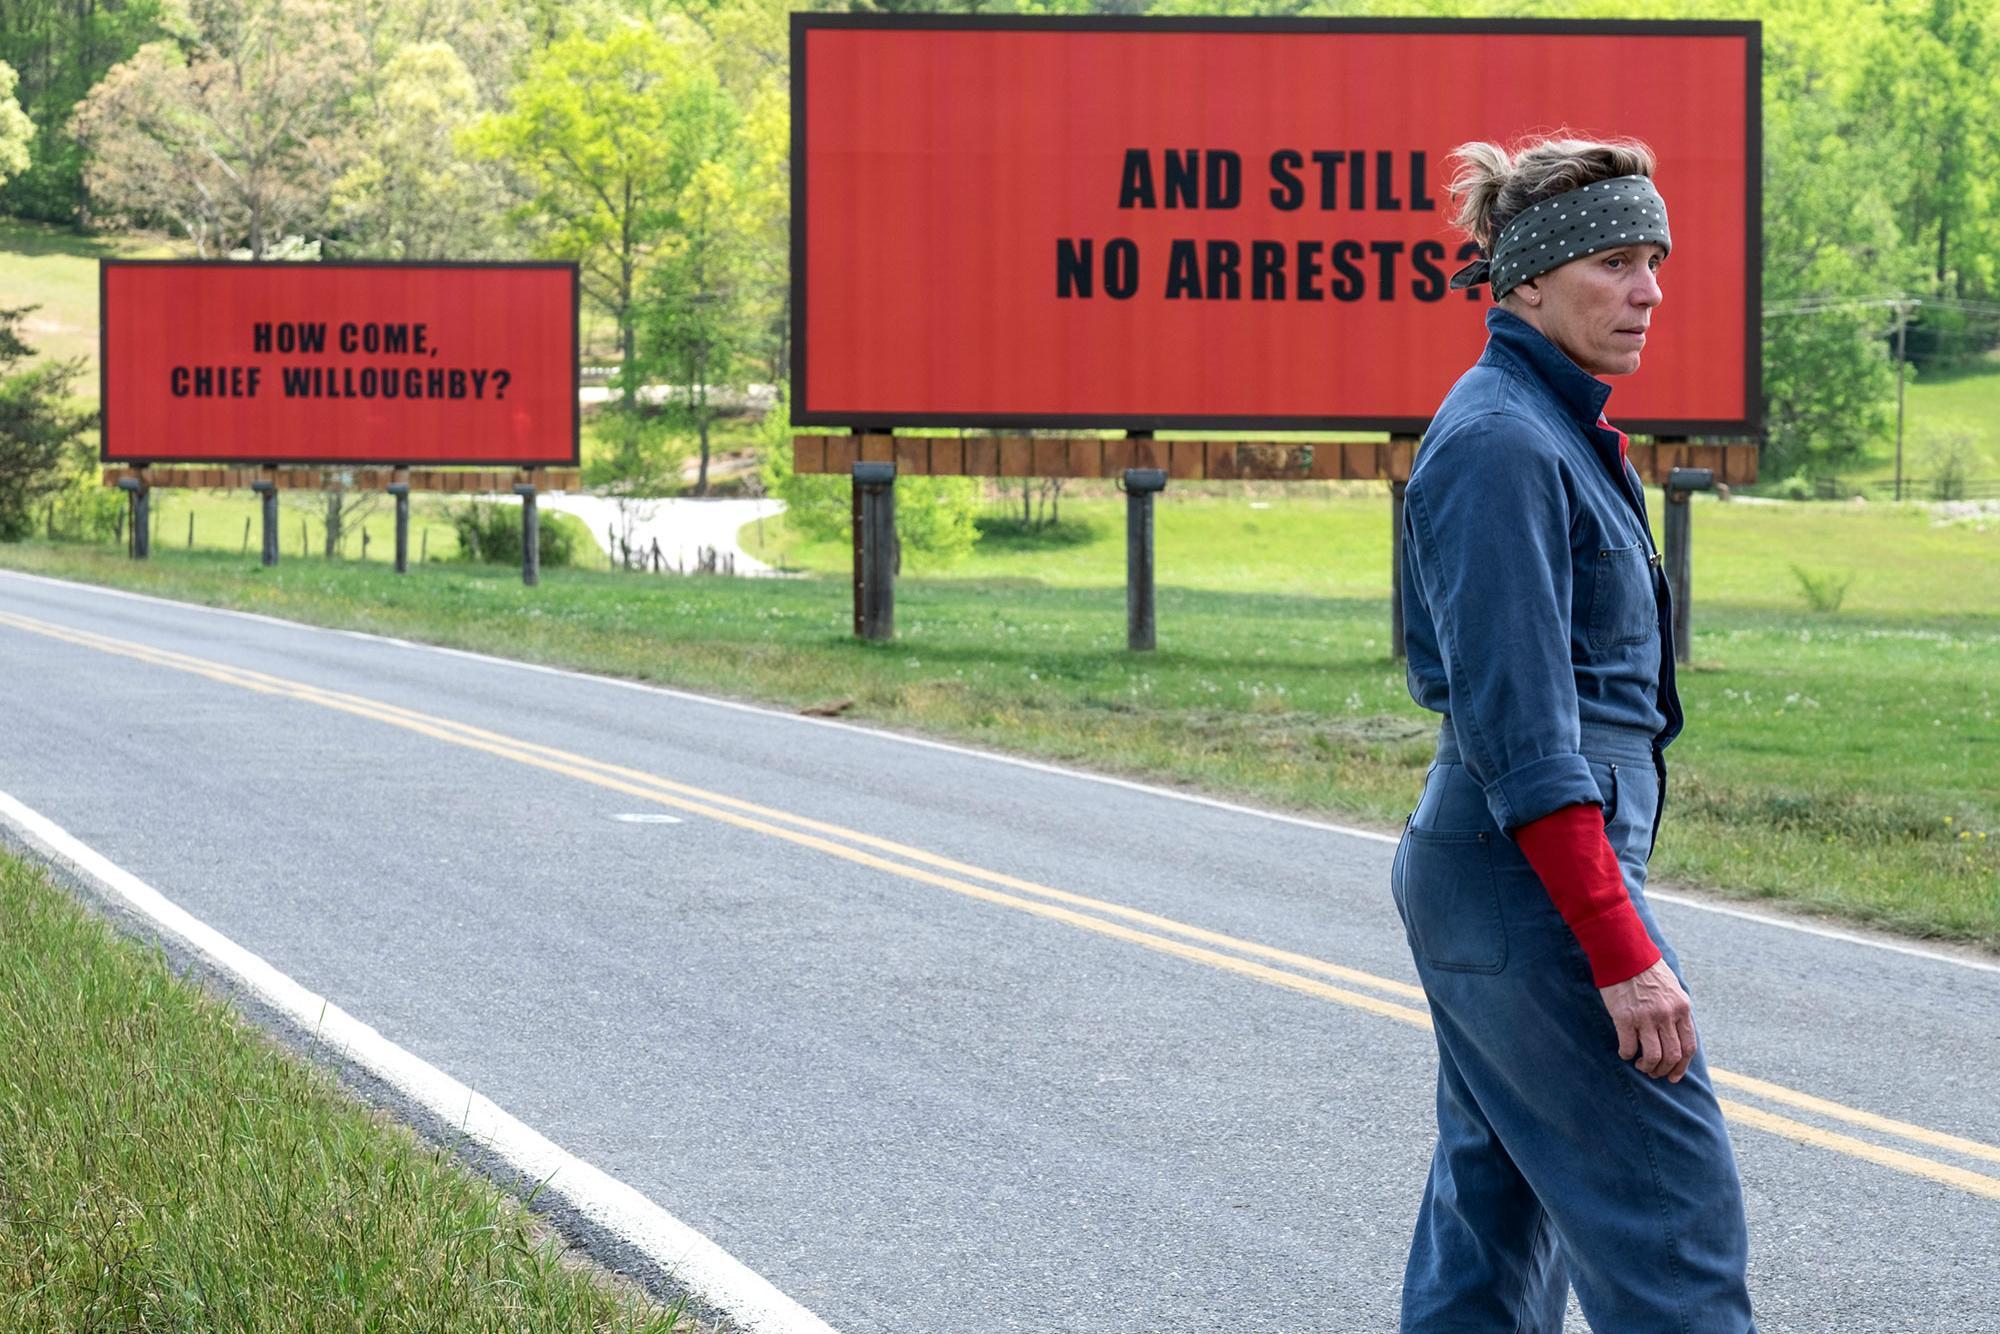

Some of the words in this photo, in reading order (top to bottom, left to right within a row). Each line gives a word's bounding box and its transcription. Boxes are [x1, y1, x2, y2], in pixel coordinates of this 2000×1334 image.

[1118, 148, 1243, 211] AND
[1269, 150, 1436, 213] STILL
[1056, 237, 1141, 301] NO
[252, 322, 328, 354] HOW
[338, 322, 438, 358] COME,
[170, 366, 262, 398] CHIEF
[282, 367, 512, 401] WILLOUGHBY?
